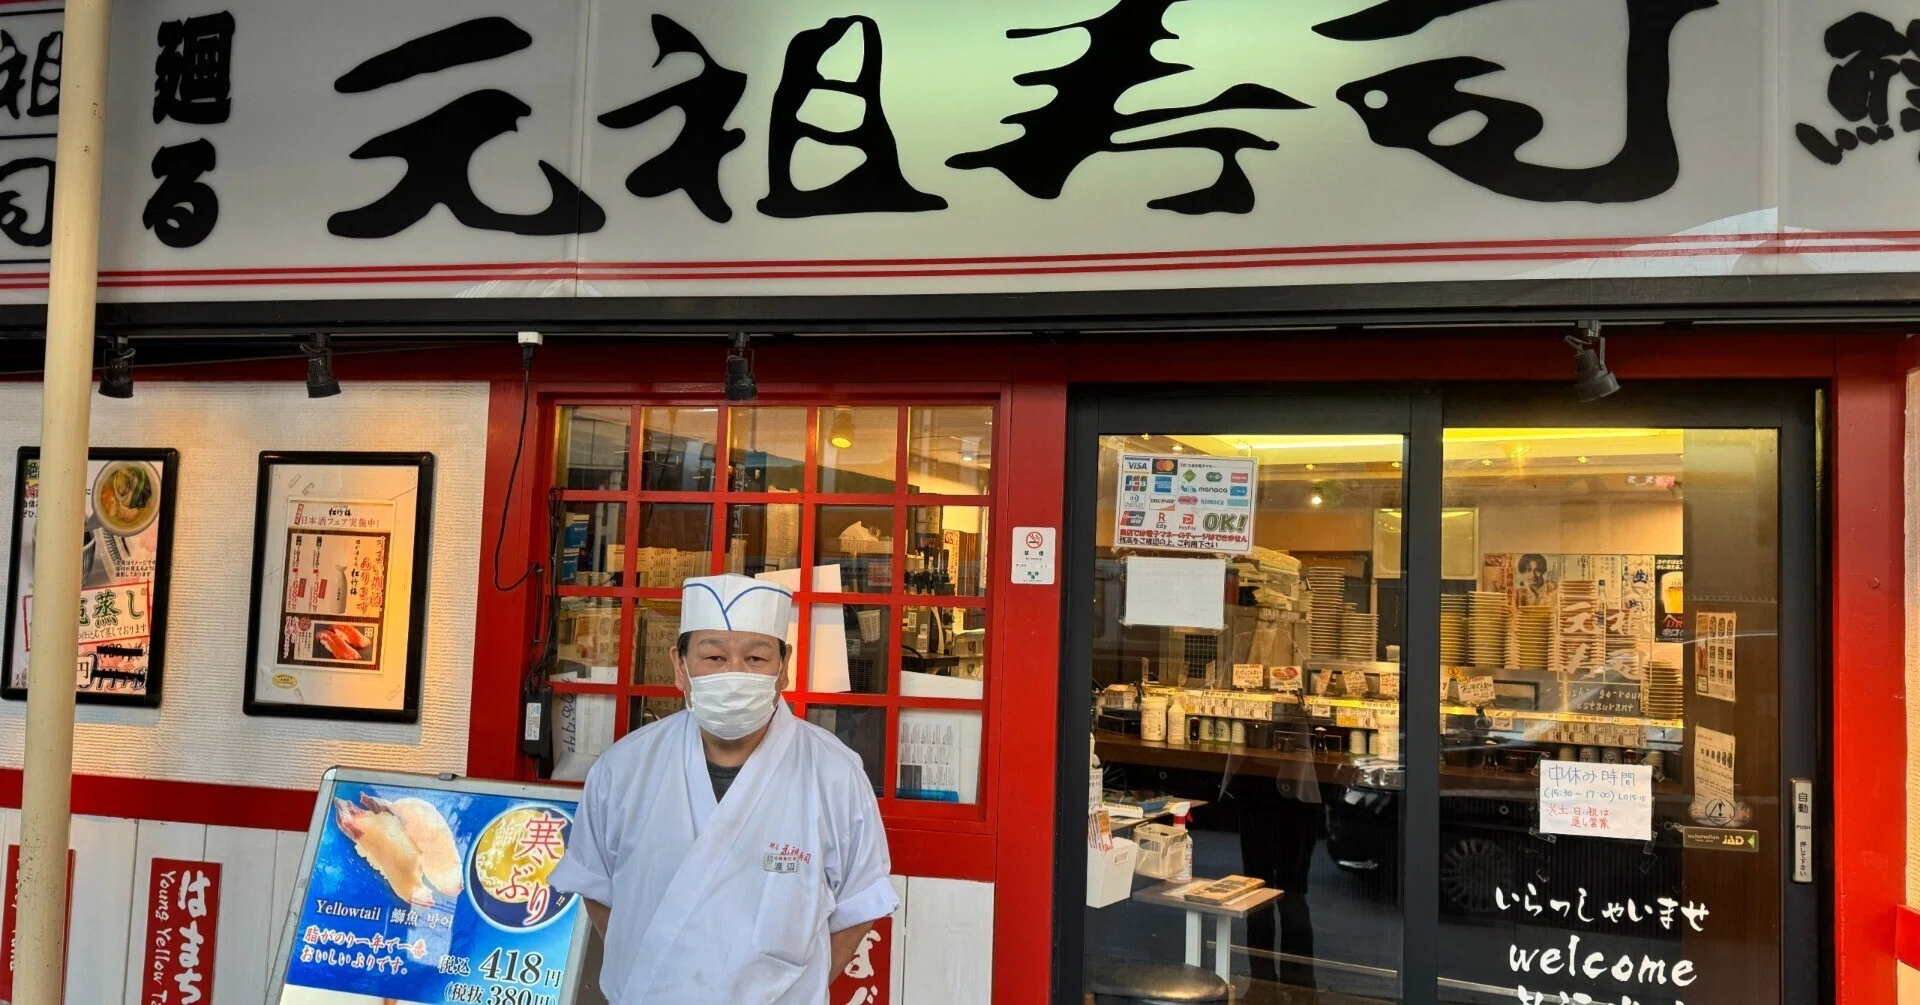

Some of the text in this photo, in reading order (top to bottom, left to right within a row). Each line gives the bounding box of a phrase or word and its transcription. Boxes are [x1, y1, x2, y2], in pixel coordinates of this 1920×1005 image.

[142, 10, 236, 248] 廻る
[327, 0, 1718, 239] 元祖寿司
[1128, 462, 1147, 470] VISA
[1200, 497, 1224, 505] nimoca
[1202, 513, 1249, 533] OK!
[1576, 700, 1634, 713] estaurant
[1548, 763, 1635, 788] 中休み時間
[1798, 792, 1809, 814] 自動
[1570, 816, 1610, 829] 通し営業
[496, 811, 566, 926] 寒ぶり
[155, 869, 177, 923] Young
[316, 899, 382, 922] Yellowtail
[1495, 882, 1710, 932] いらっしゃいませ
[174, 870, 211, 1005] はまち
[303, 924, 428, 958] 脂がのり一年で一番
[152, 927, 173, 986] Yellow
[437, 954, 471, 977] 税込
[1508, 934, 1698, 988] welcome
